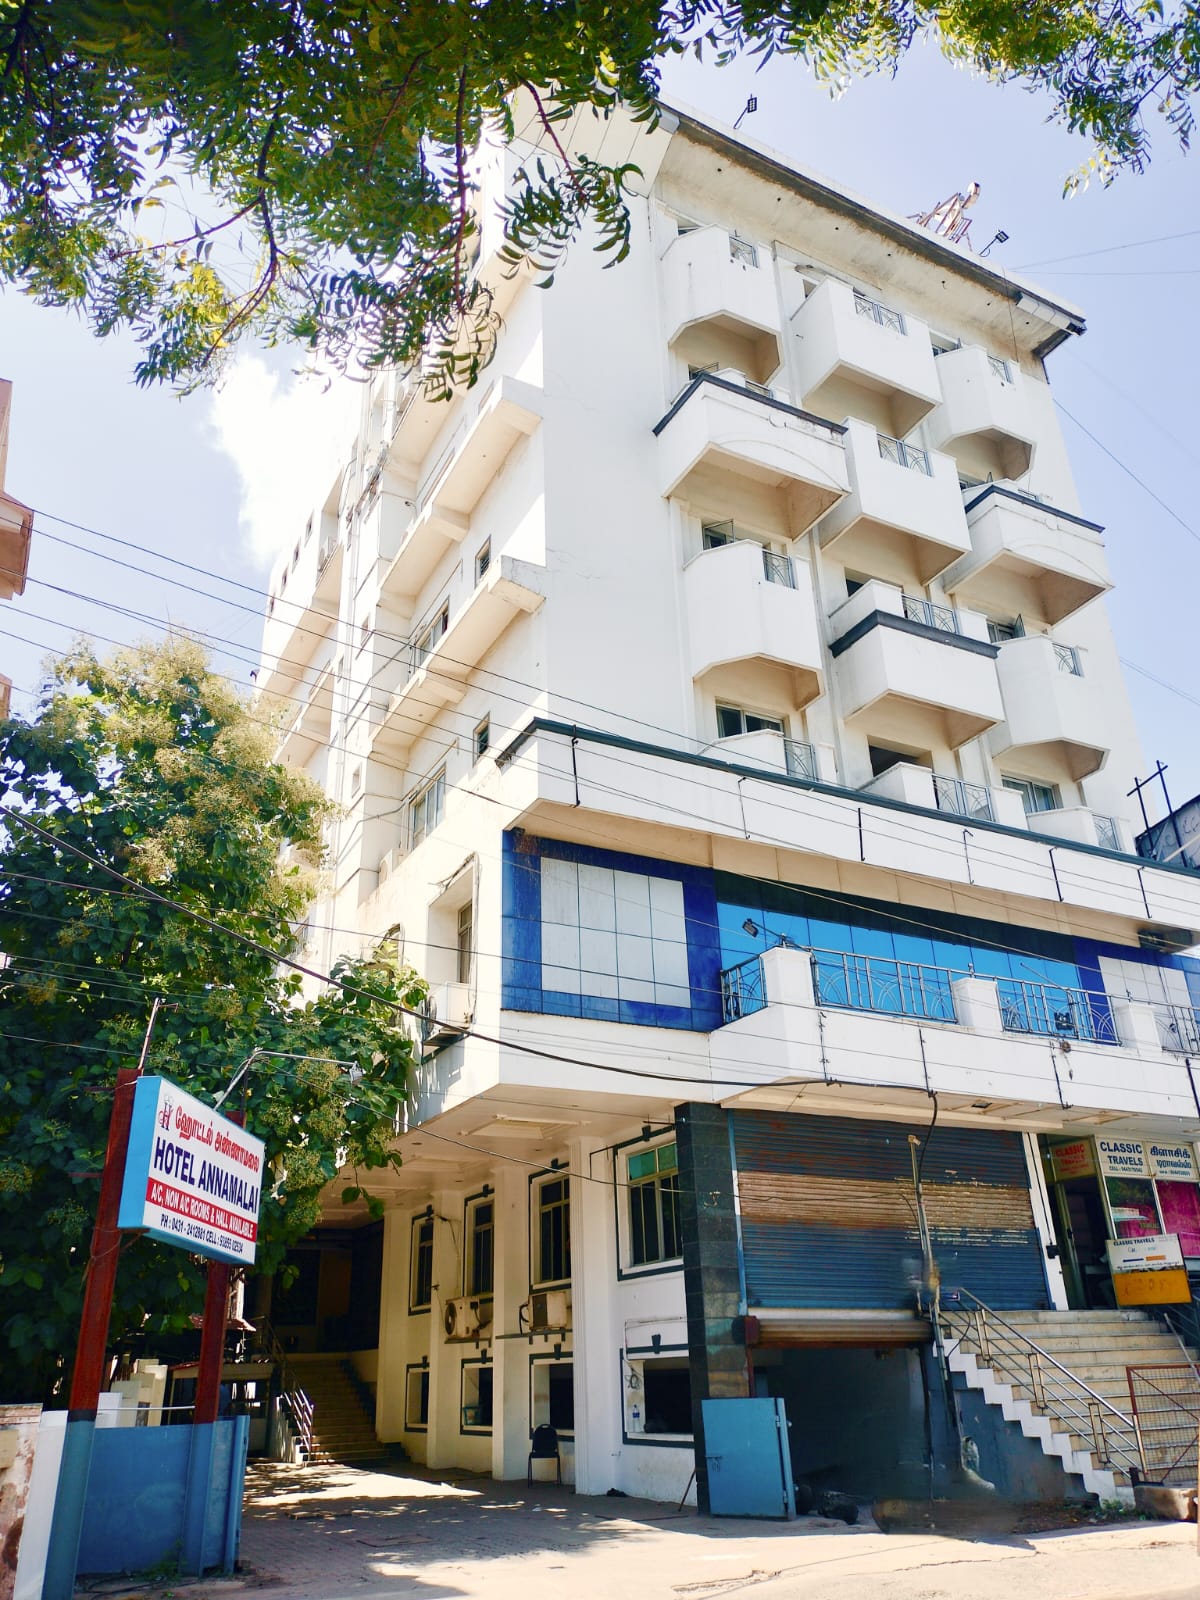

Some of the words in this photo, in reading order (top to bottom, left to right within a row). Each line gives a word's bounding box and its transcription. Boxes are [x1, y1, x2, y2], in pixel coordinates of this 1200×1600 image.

[1056, 1144, 1084, 1156] CLASSIC
[1100, 1142, 1142, 1153] CLASSIC
[1107, 1156, 1143, 1166] TRAVELS
[153, 1136, 196, 1186] HOTEL
[198, 1160, 258, 1214] ANNAMALAI
[164, 1188, 179, 1209] NON
[190, 1199, 210, 1222] ROOMS
[210, 1207, 215, 1224] &
[215, 1209, 229, 1228] HALL
[229, 1214, 253, 1238] AVAILABLE
[205, 1230, 217, 1244] CELL
